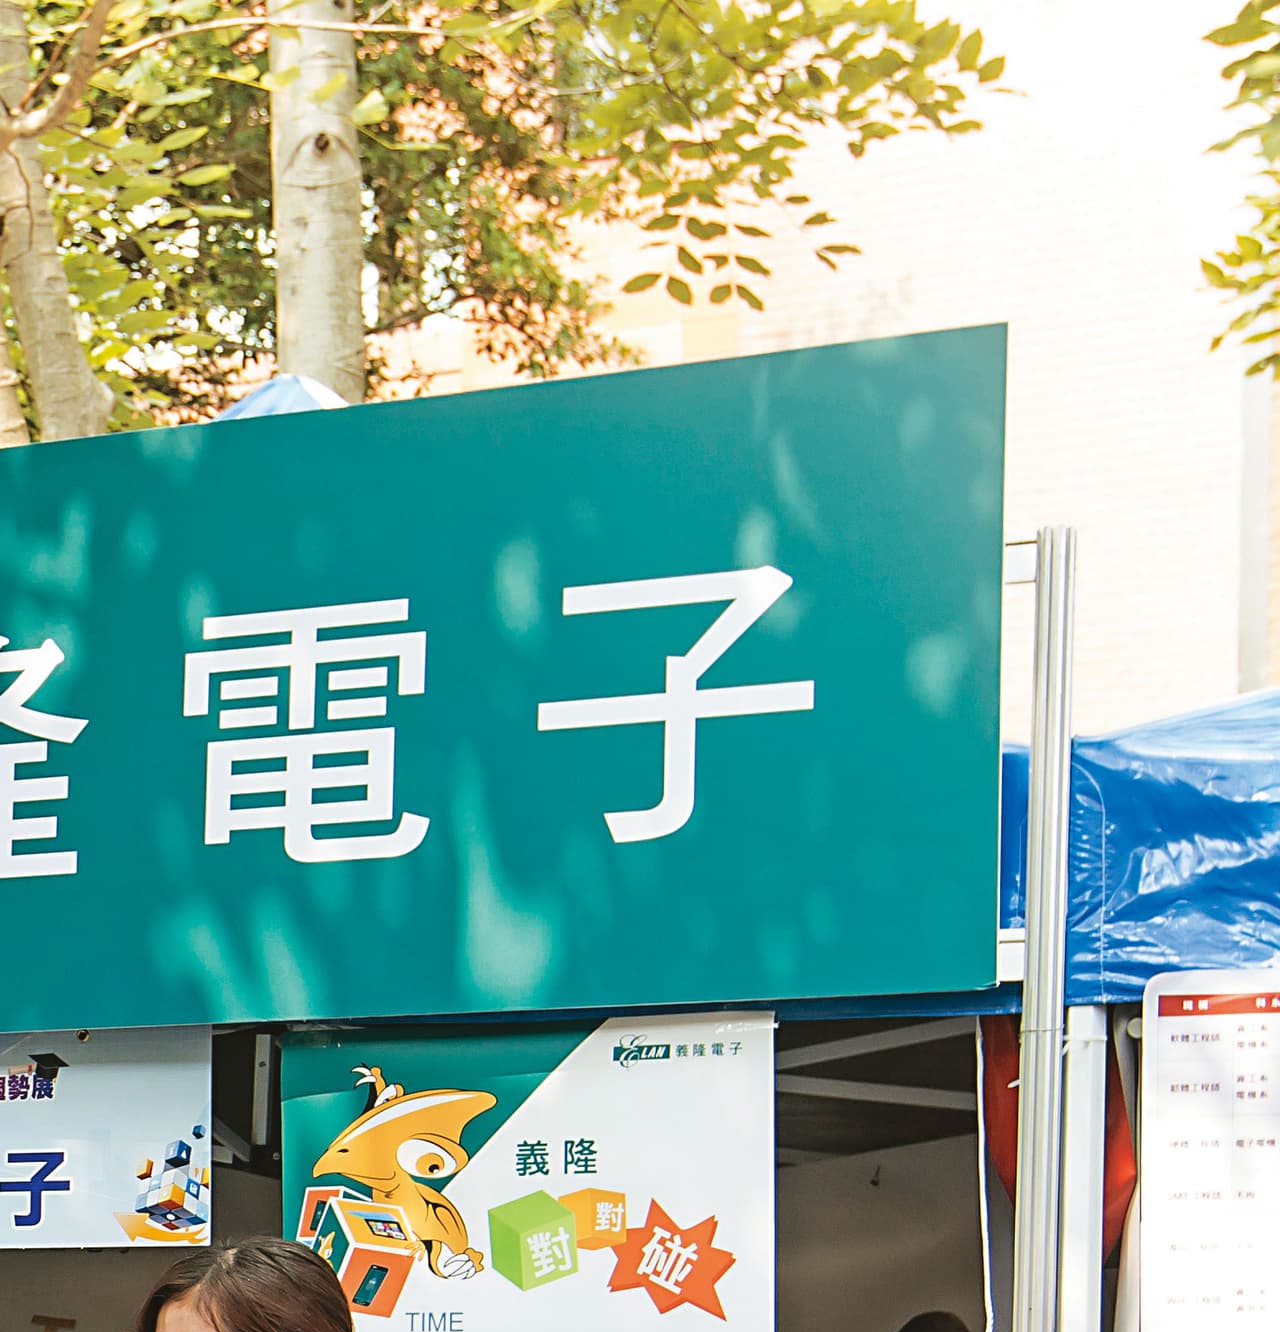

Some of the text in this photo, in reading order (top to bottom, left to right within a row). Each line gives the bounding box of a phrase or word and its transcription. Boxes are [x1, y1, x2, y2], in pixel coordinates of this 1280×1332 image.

[618, 1034, 667, 1071] ELAN
[674, 1041, 744, 1058] 義隆電子
[516, 1137, 599, 1177] 義隆
[526, 1201, 699, 1295] 對 對 碰
[405, 1311, 465, 1332] TIME
